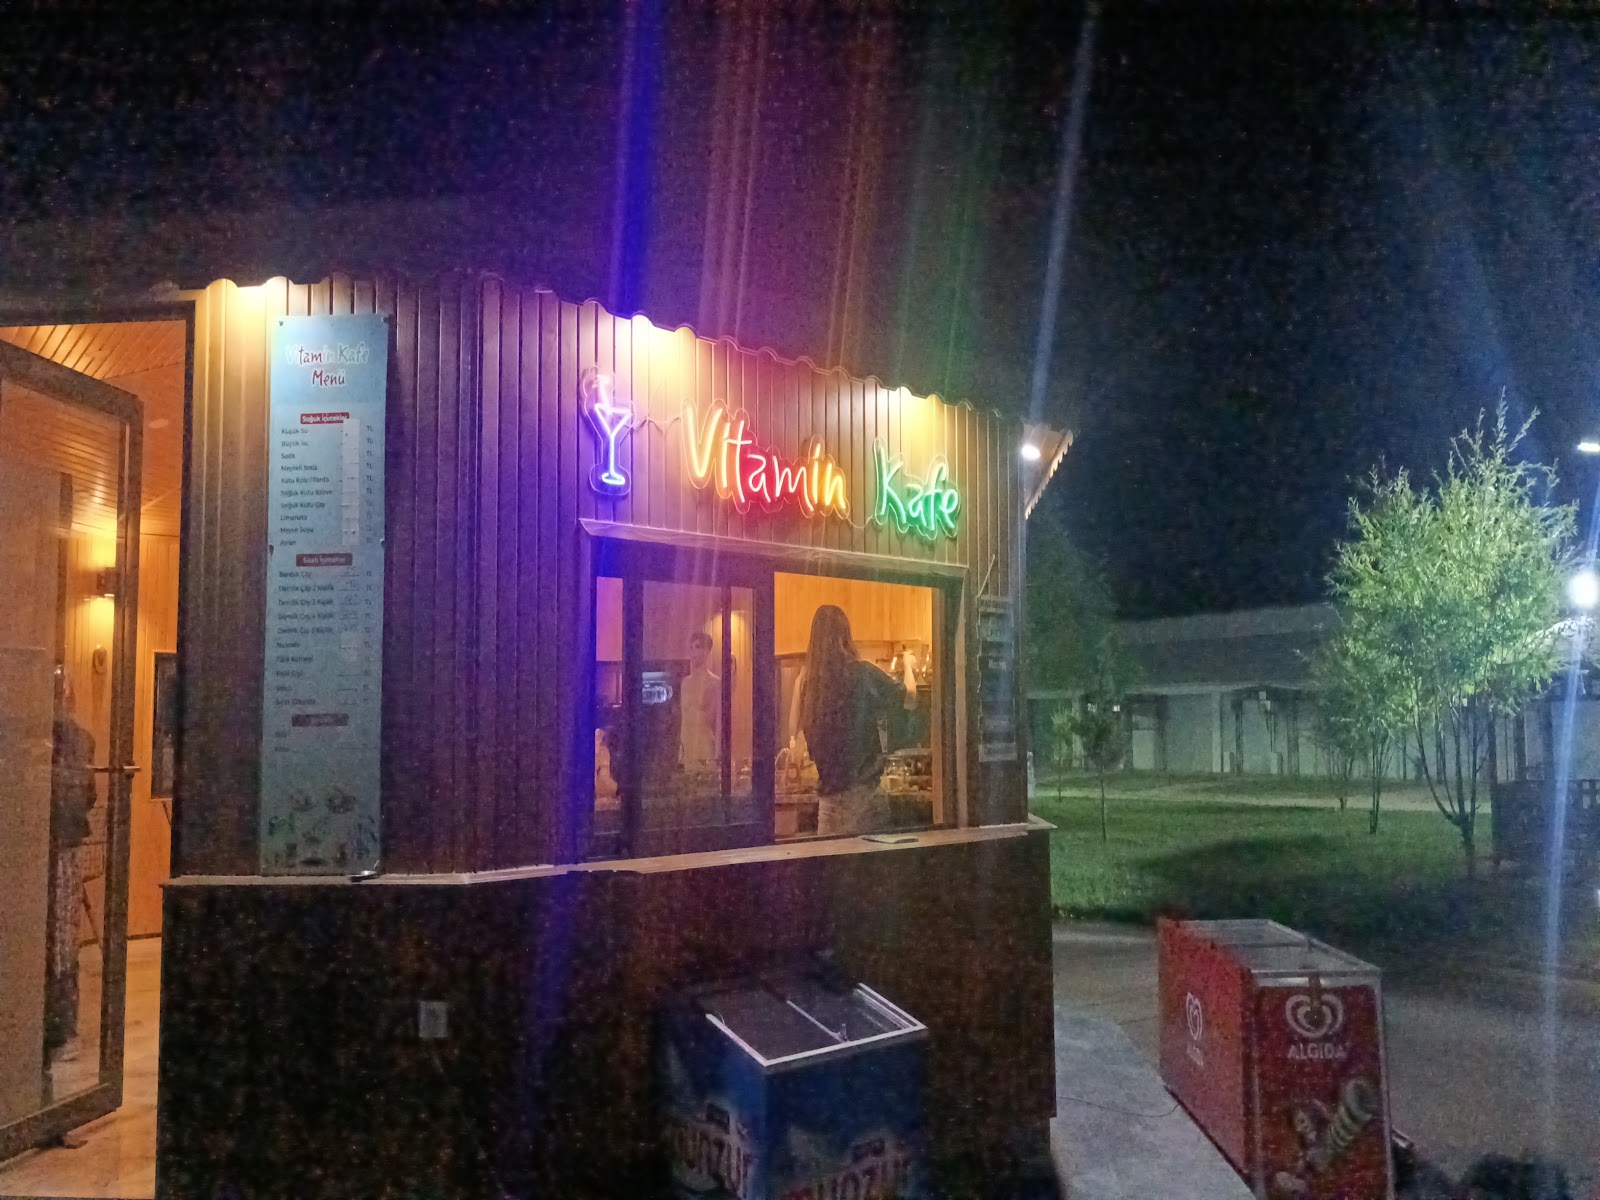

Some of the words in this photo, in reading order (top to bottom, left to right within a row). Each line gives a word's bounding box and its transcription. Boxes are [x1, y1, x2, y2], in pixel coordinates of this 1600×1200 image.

[337, 341, 370, 364] Kafe
[312, 369, 345, 386] Menü
[365, 462, 373, 470] TL
[684, 402, 848, 515] Vitamin
[874, 441, 961, 533] Kafe
[365, 474, 373, 482] TL
[365, 487, 373, 495] TL
[1287, 1042, 1349, 1060] ALGIDA
